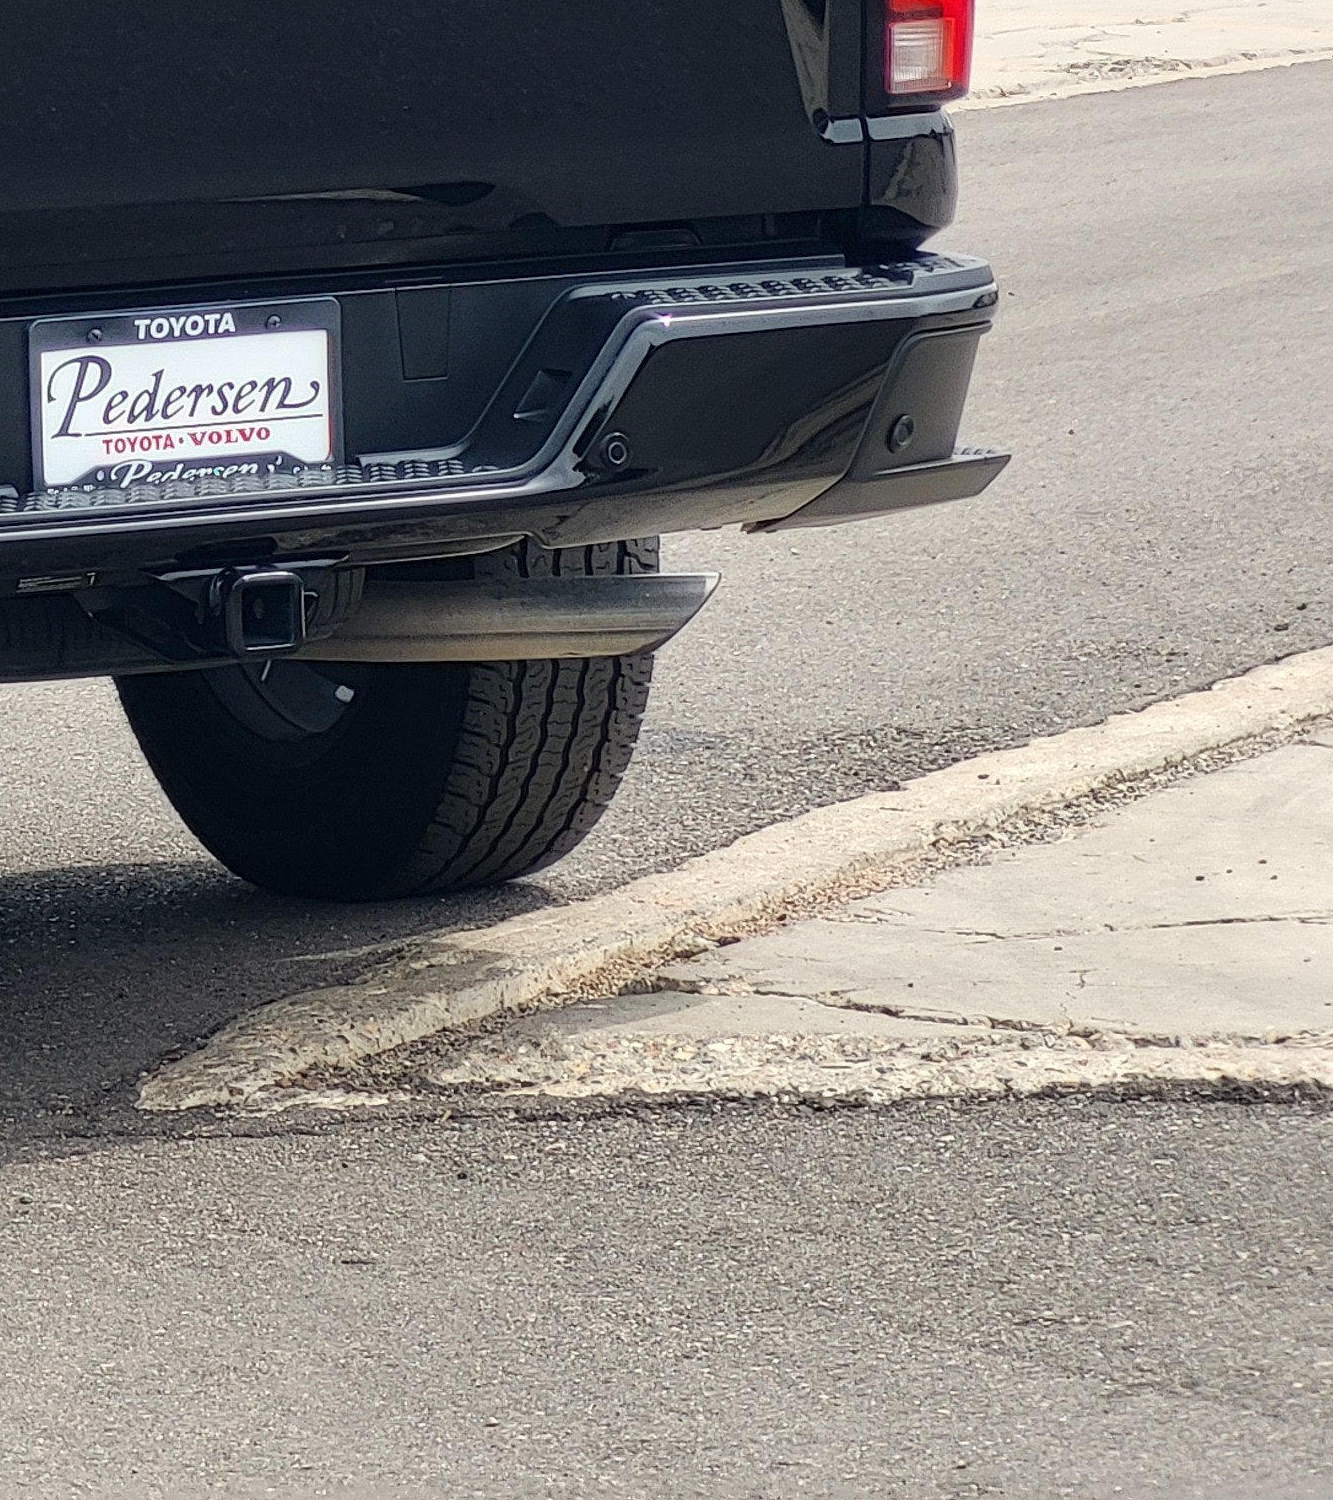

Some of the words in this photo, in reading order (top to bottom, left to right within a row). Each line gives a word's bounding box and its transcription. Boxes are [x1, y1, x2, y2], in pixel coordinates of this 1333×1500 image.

[134, 312, 236, 340] TOYOTA
[47, 355, 320, 440] Pedersen
[102, 435, 175, 455] TOYOTA
[189, 427, 271, 447] VOLVO
